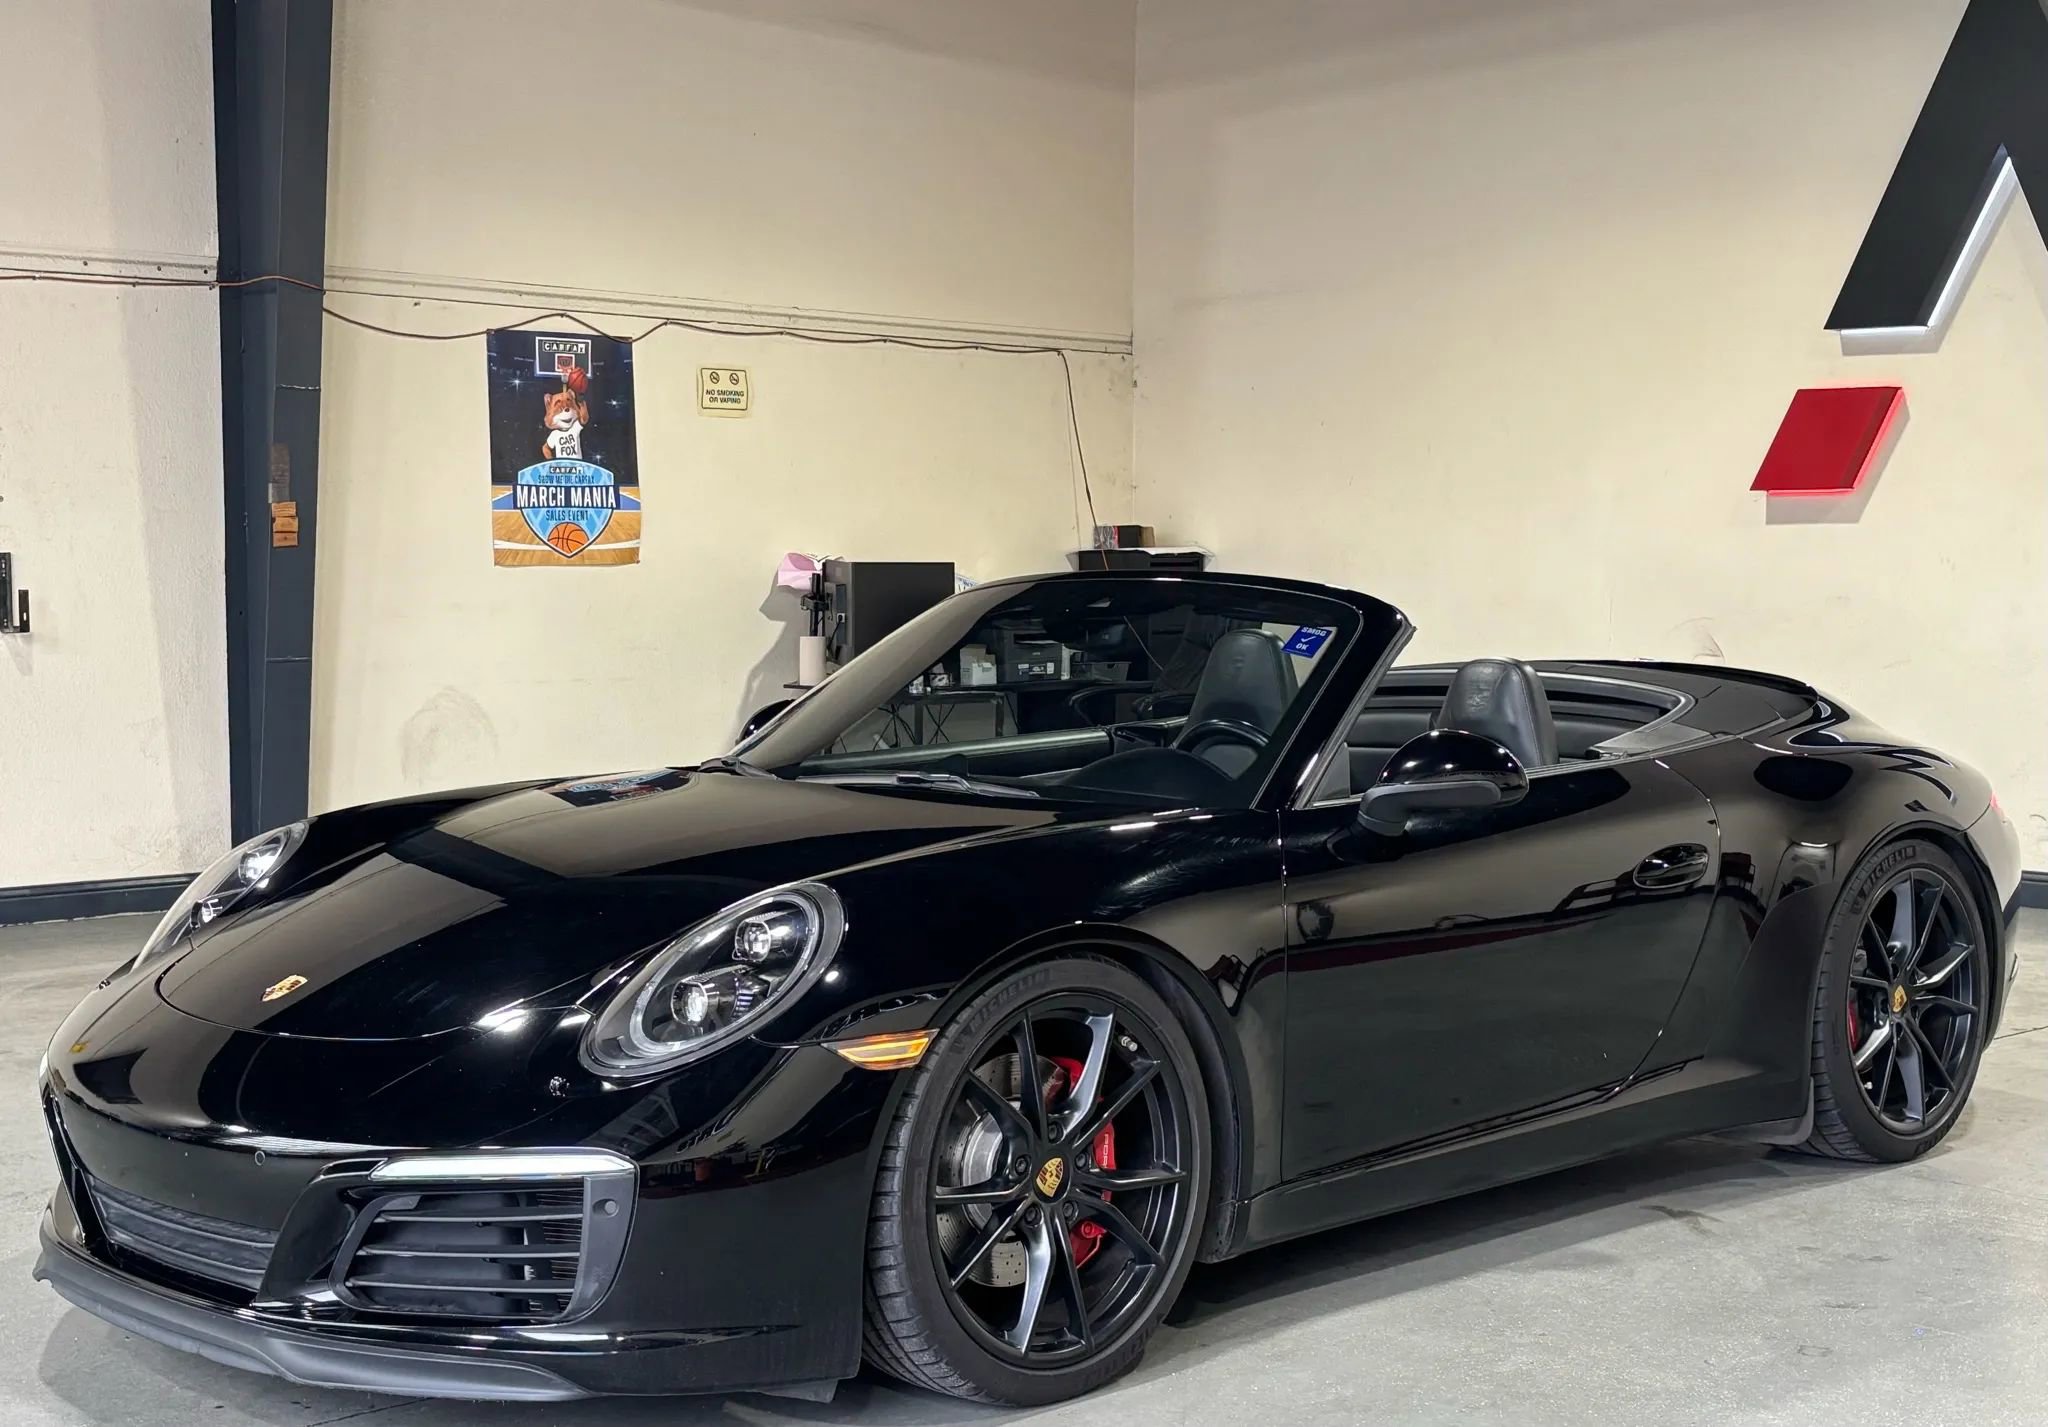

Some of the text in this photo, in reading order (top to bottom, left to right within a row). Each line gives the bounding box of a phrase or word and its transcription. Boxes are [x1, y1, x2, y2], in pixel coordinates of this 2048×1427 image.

[543, 342, 585, 353] CARFAX
[717, 389, 744, 397] SMOKING
[559, 434, 575, 446] CAR
[561, 445, 577, 456] FOX
[516, 485, 617, 508] MARCH MANIA
[545, 510, 589, 521] SALES EVENT
[1296, 642, 1309, 650] OK
